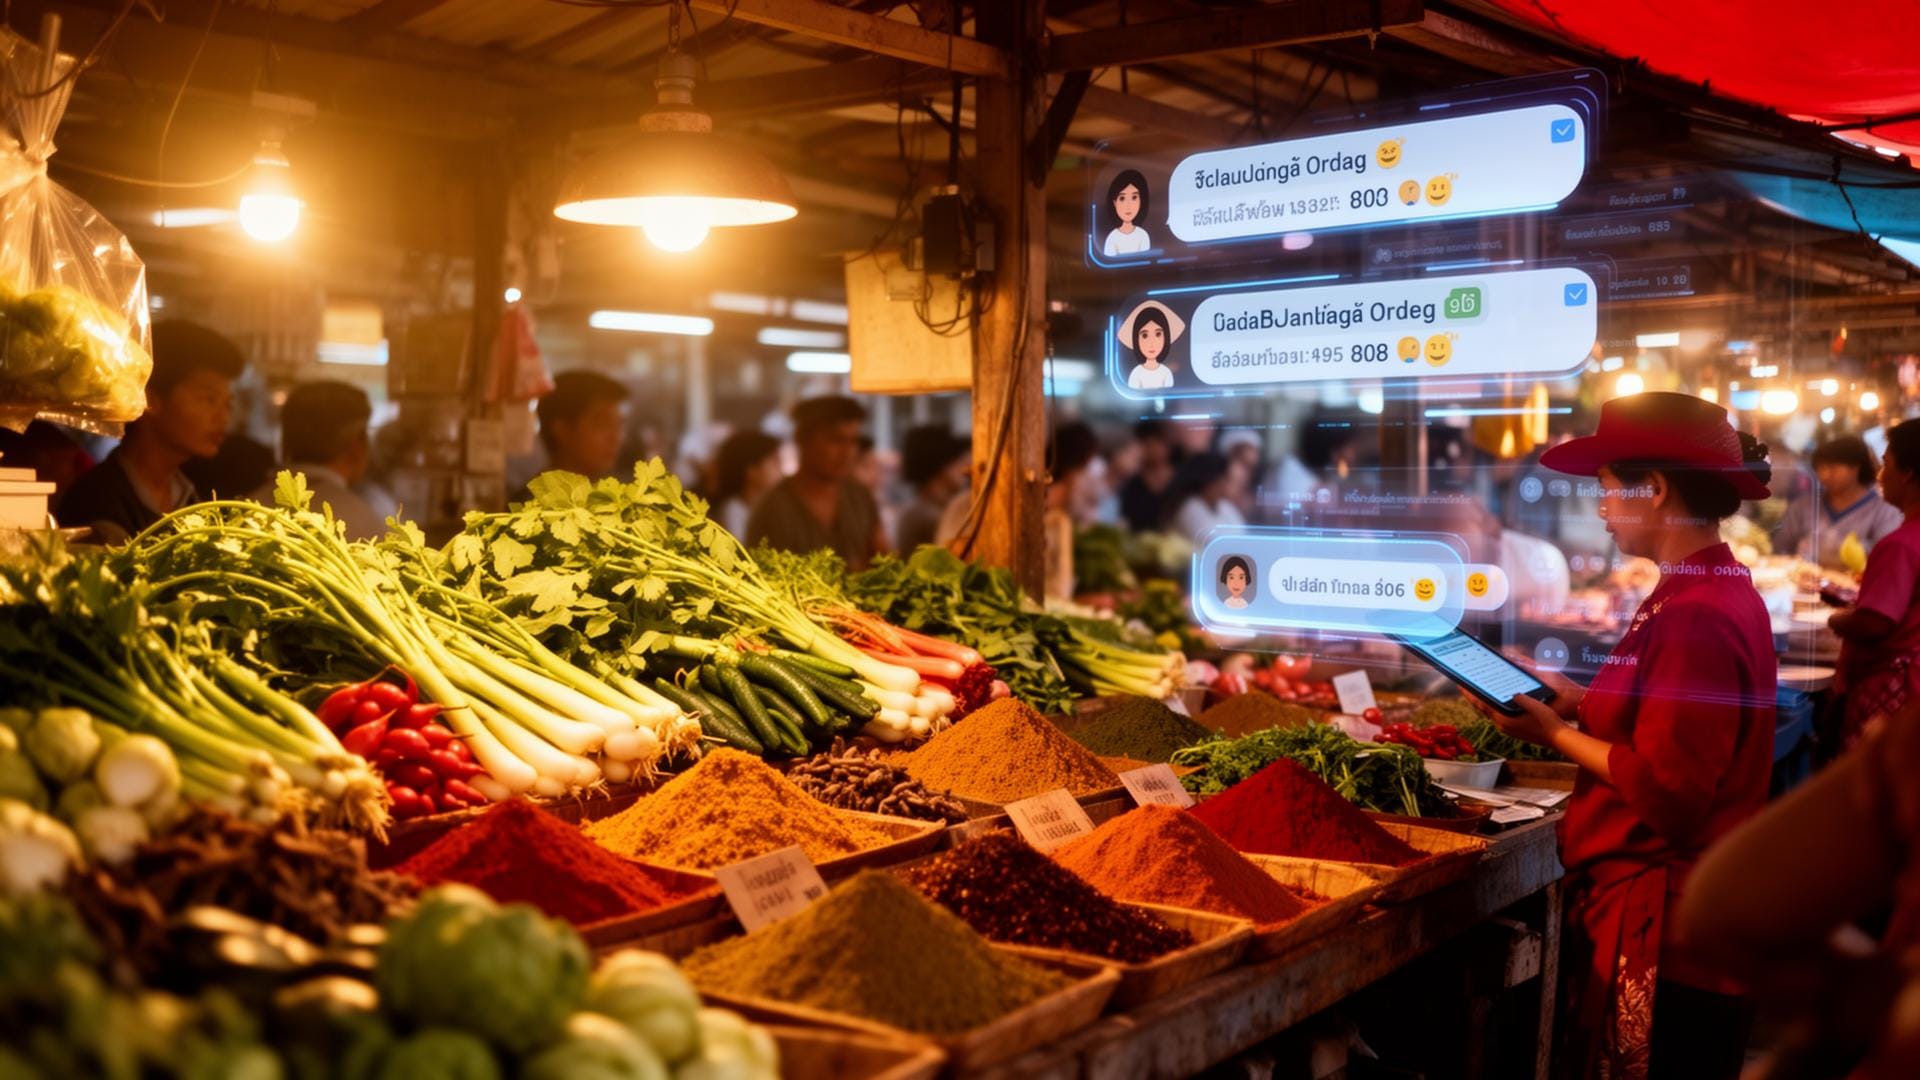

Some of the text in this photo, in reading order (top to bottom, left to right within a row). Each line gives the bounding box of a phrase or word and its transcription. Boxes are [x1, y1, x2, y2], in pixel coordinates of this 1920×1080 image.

[1306, 151, 1367, 174] Ordag
[1369, 300, 1436, 323] Ordeg
[1351, 343, 1389, 363] 808
